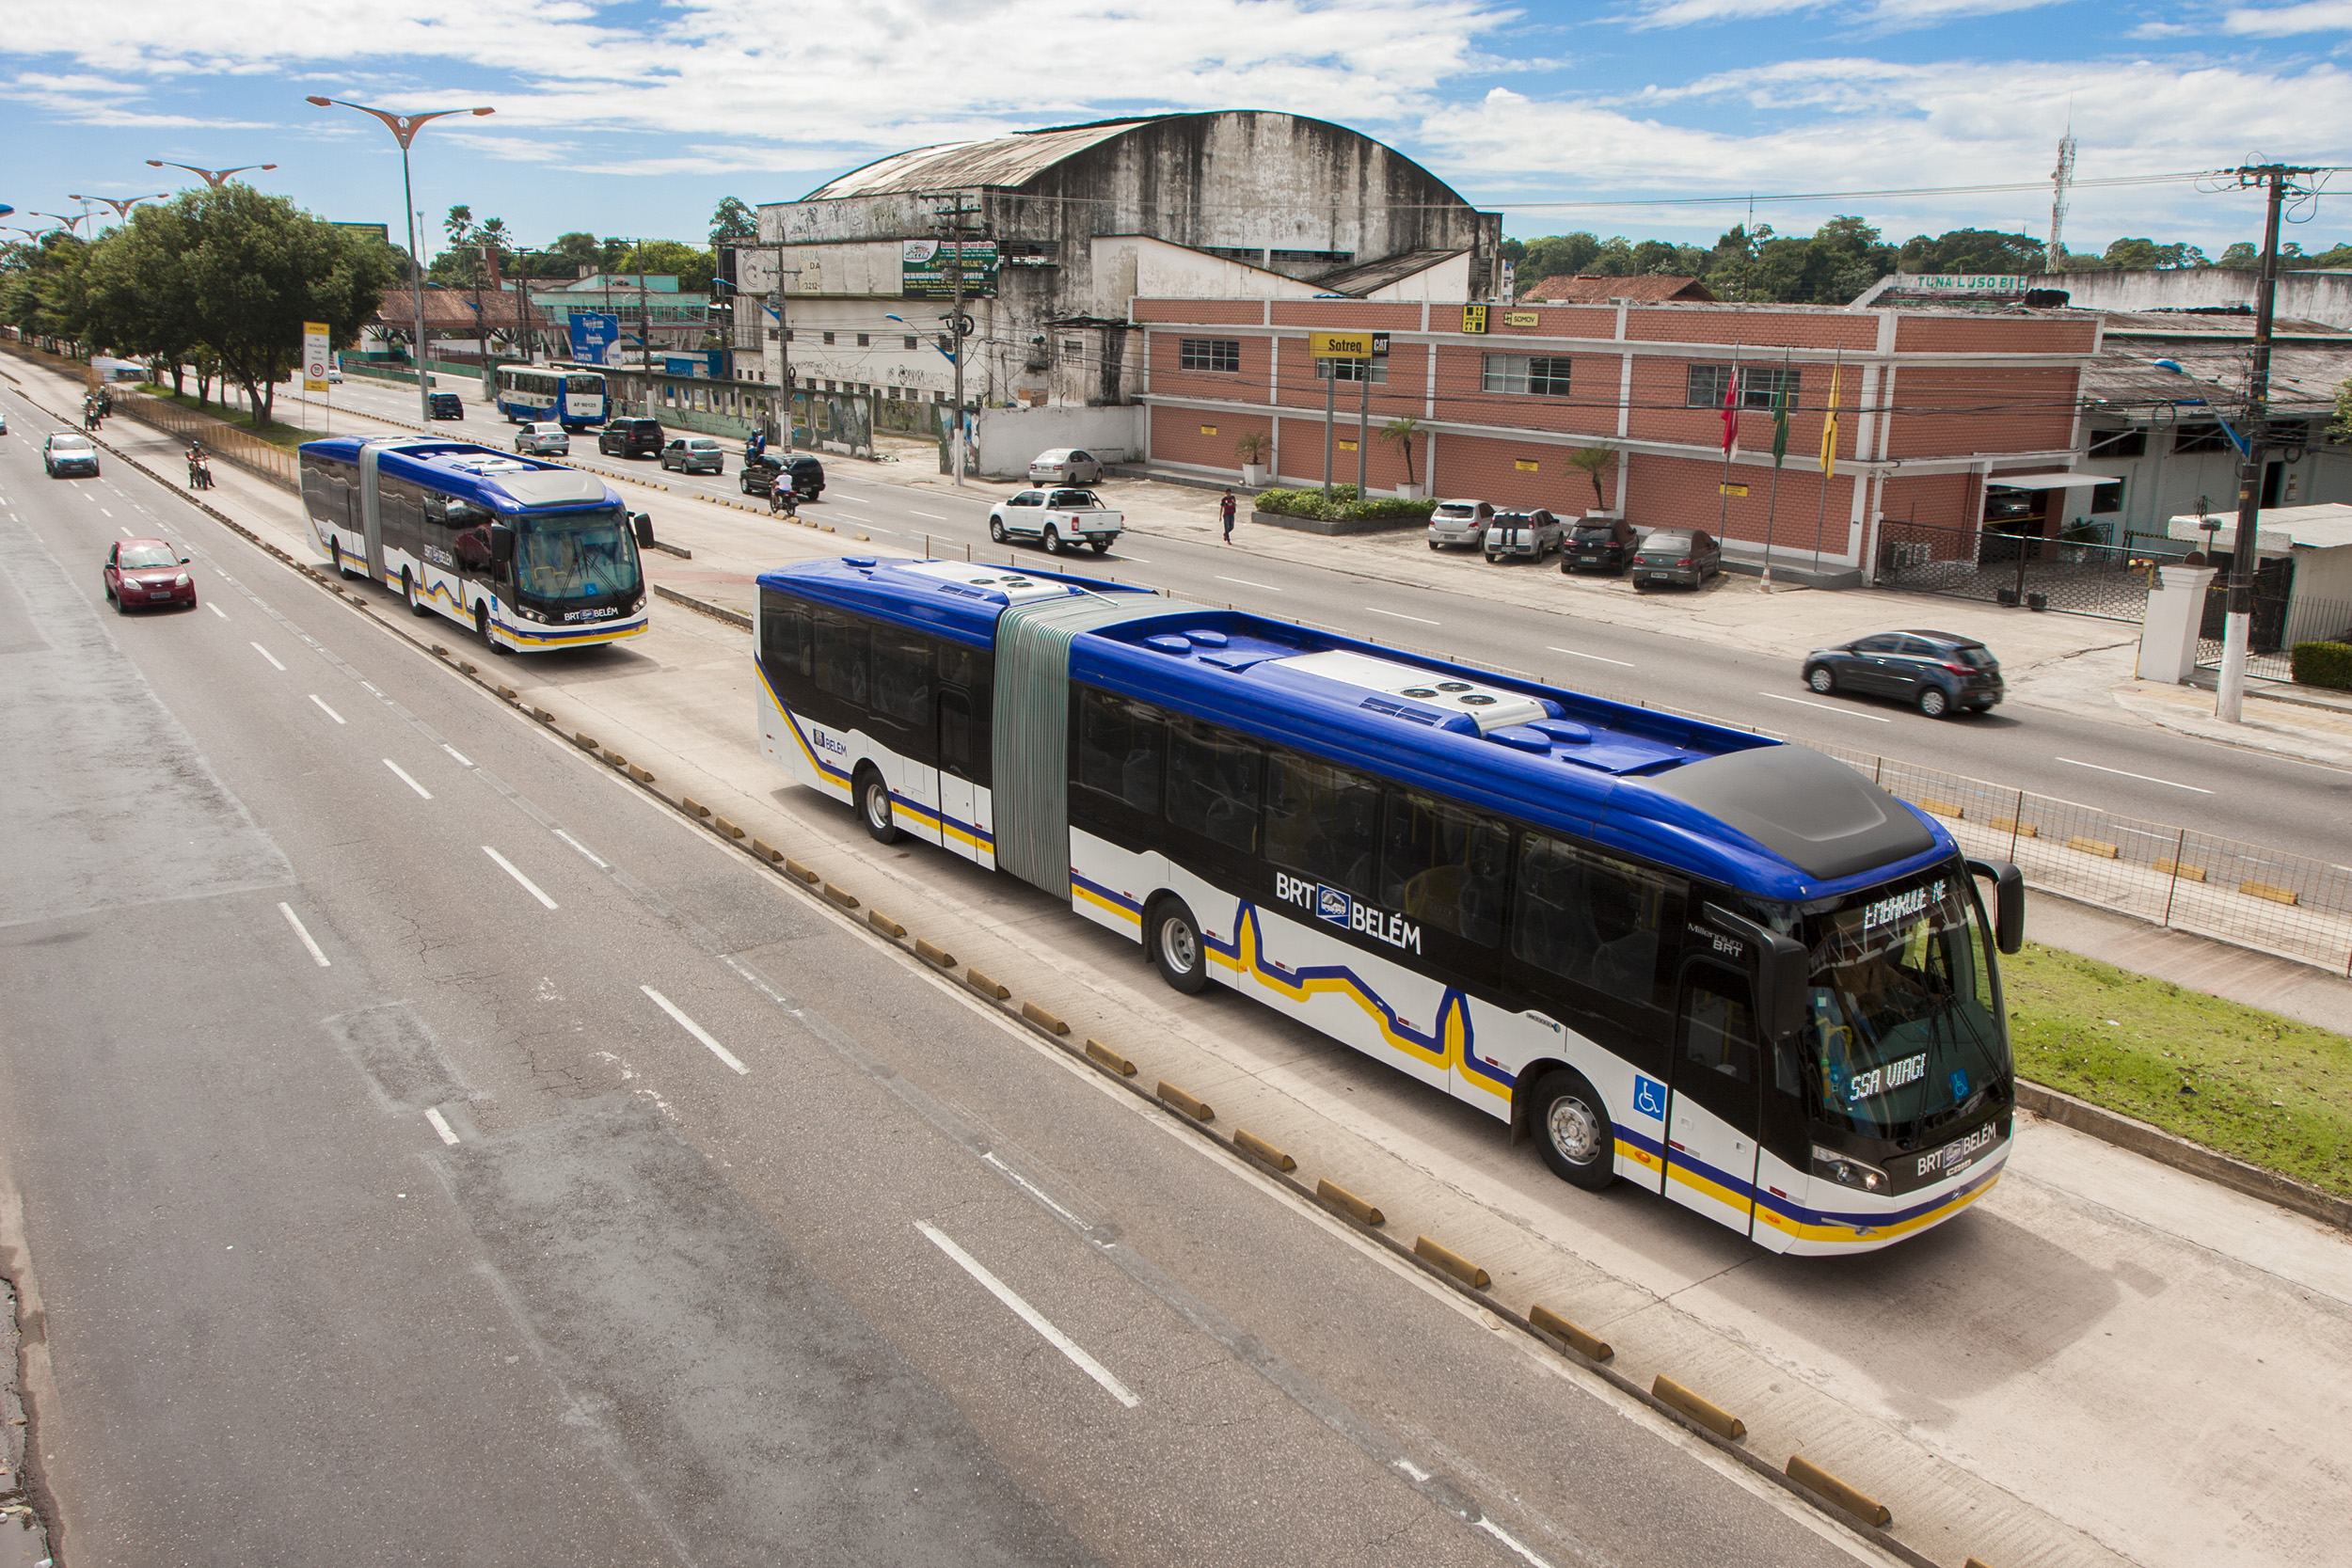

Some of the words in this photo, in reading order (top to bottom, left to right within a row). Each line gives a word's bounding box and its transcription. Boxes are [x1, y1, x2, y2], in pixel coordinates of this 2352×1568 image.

[1918, 277, 1953, 289] TUNA
[1957, 277, 1996, 289] LUSO
[1514, 315, 1535, 324] SOMOV
[1328, 339, 1362, 355] Sotreq
[1374, 339, 1389, 352] CAT
[564, 610, 580, 621] BRT
[594, 607, 619, 618] BELÉM
[1276, 871, 1316, 911] BRT
[1352, 901, 1422, 956] BELÉM
[1864, 887, 1928, 930] EMBARQUE
[1687, 923, 1743, 950] Millennium
[1712, 939, 1743, 958] BRT
[1850, 1069, 1882, 1101] SSA
[1917, 1148, 1944, 1177] BRT
[1963, 1121, 1996, 1156] BELÉM
